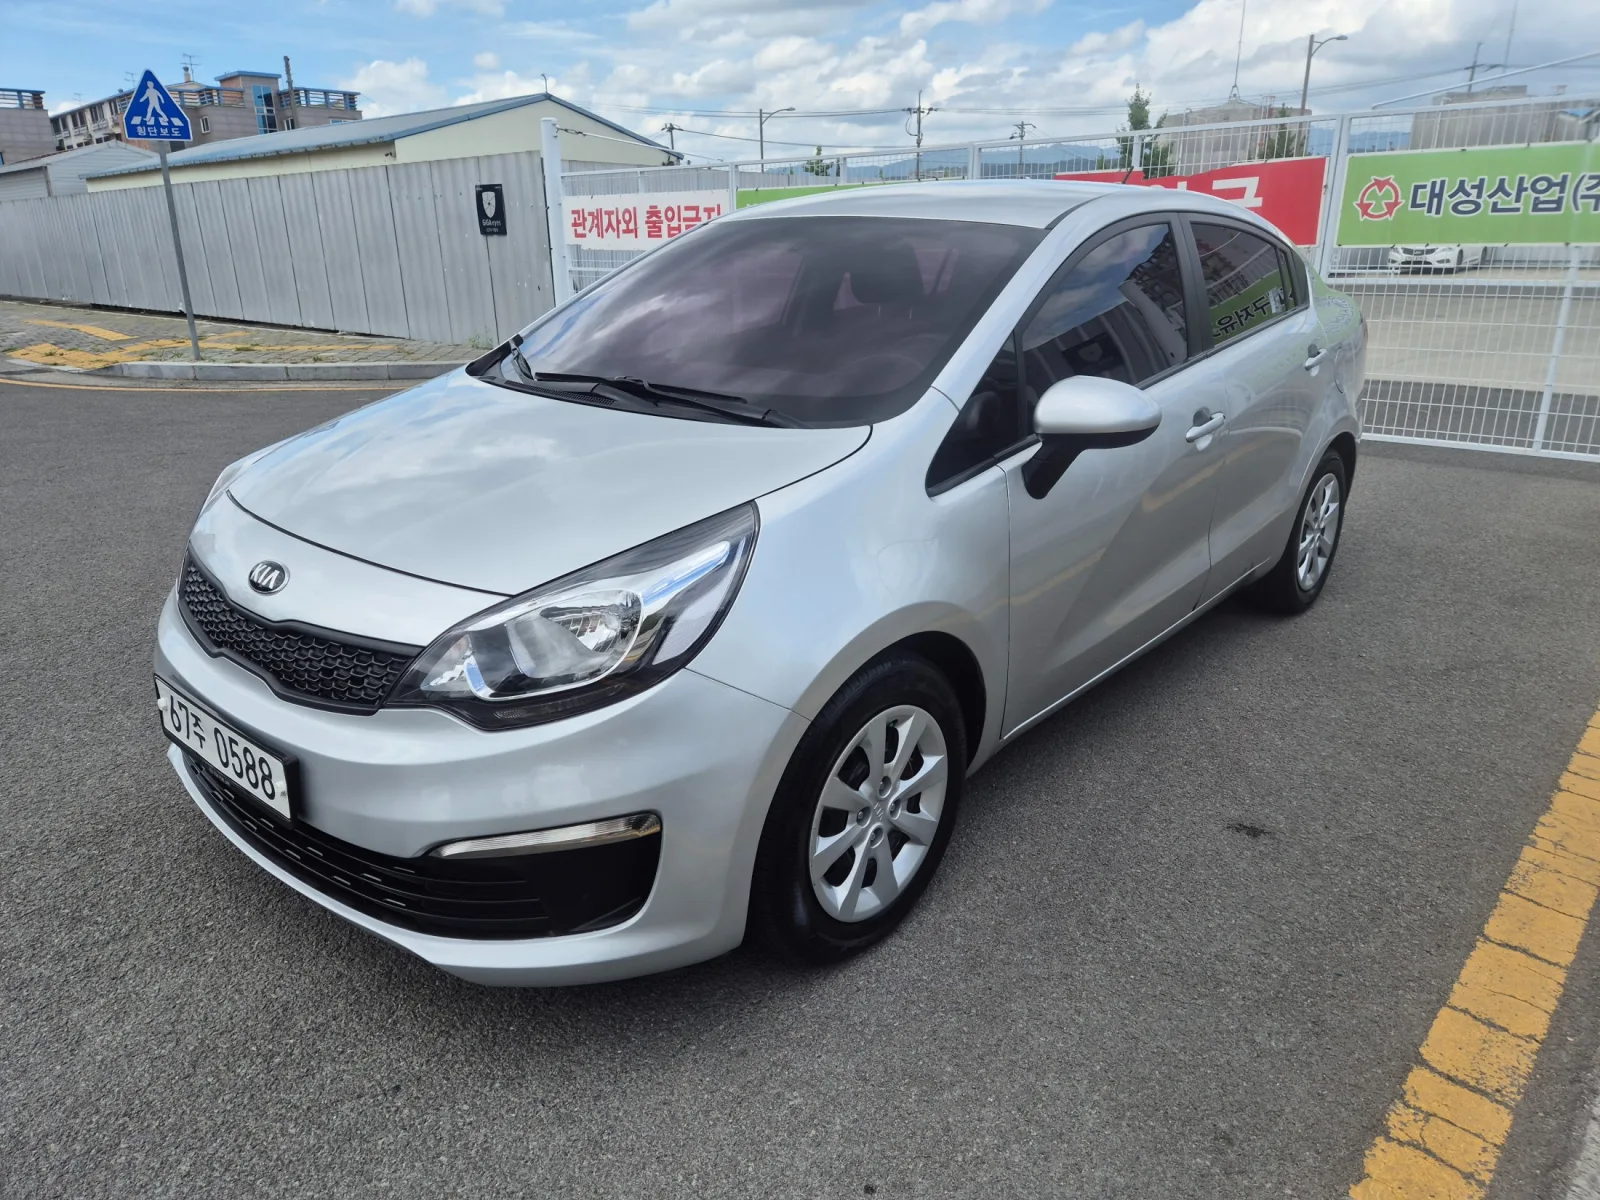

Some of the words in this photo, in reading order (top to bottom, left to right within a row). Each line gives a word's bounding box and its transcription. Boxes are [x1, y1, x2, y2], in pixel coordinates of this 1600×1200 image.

[136, 126, 182, 136] 횡단보도
[570, 206, 639, 239] 관계자외
[169, 695, 207, 750] 67주
[213, 727, 276, 801] 0588
